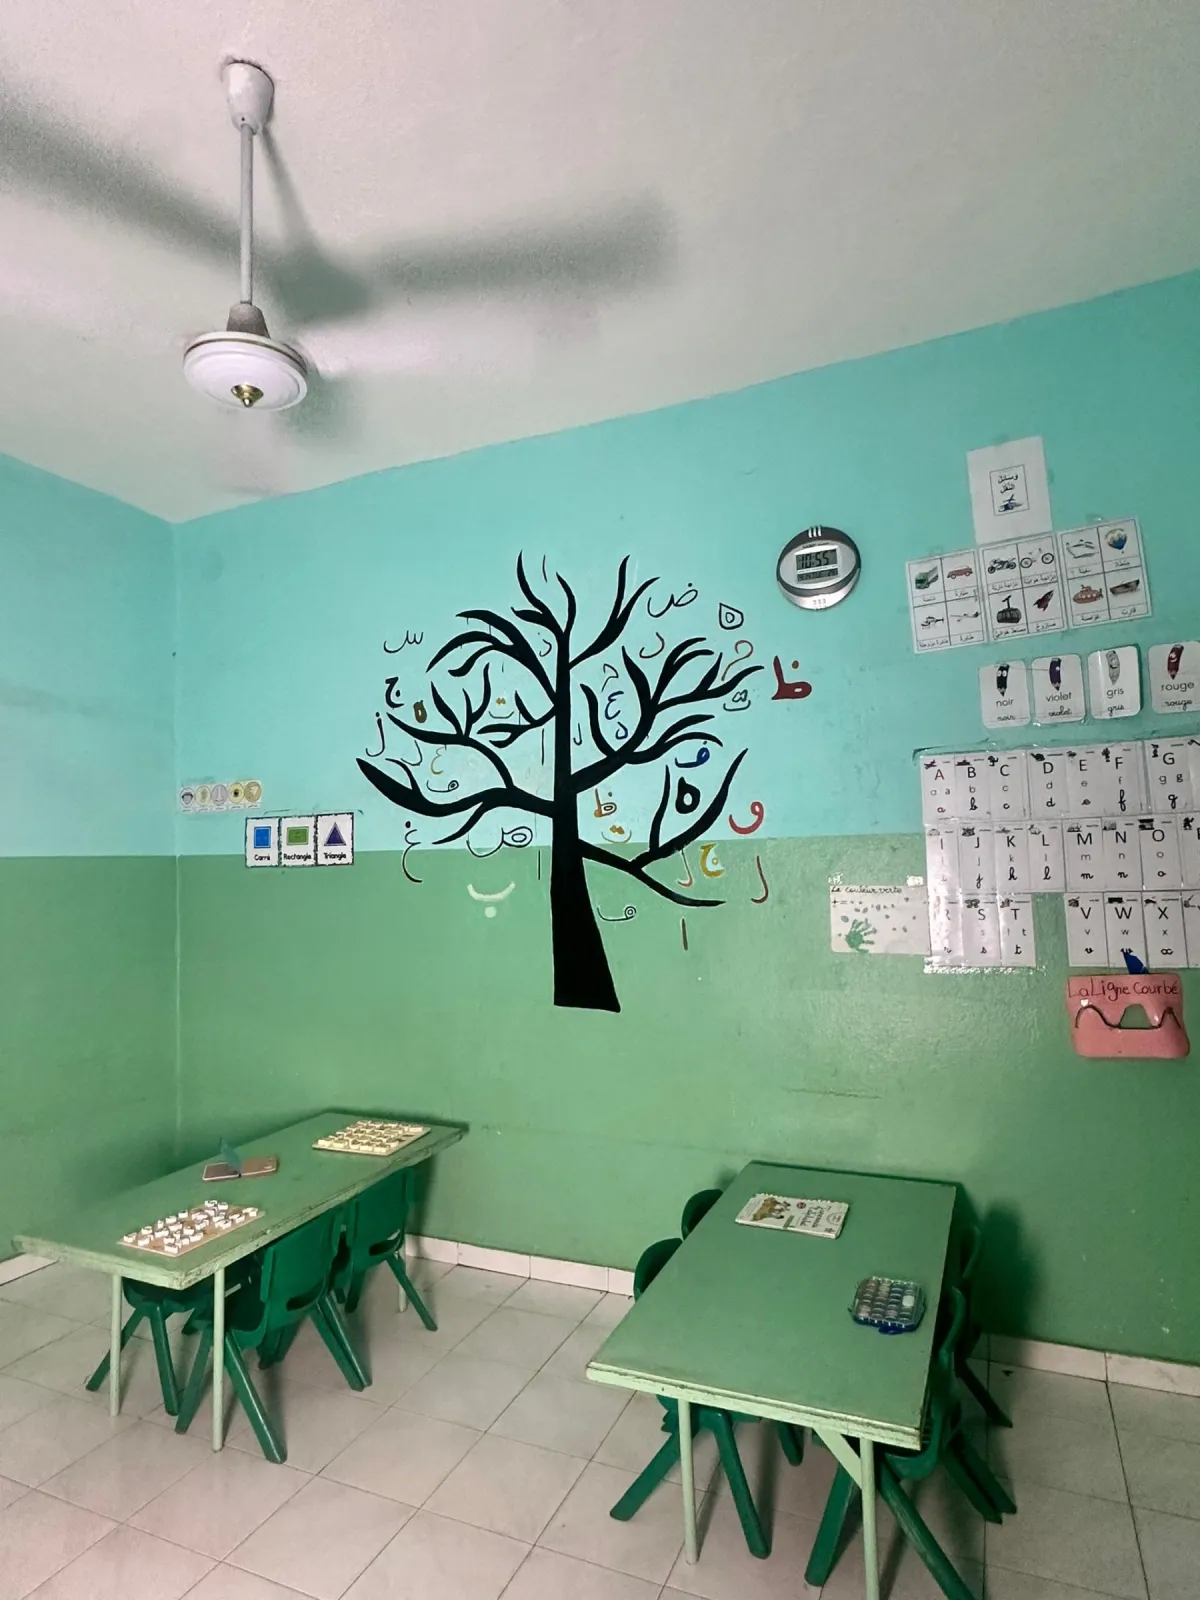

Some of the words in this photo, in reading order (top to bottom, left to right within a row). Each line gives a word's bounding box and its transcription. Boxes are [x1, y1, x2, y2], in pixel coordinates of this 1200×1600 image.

[801, 549, 829, 569] 10:55
[646, 582, 698, 618] ض
[383, 629, 424, 653] س
[771, 655, 812, 700] ظ
[1161, 682, 1195, 692] rouge
[385, 676, 405, 709] ج
[1046, 692, 1072, 702] violet
[1106, 687, 1125, 699] gris
[604, 690, 624, 720] ع
[996, 699, 1014, 707] noir
[1049, 705, 1072, 716] violet
[1108, 705, 1124, 717] gris
[1165, 699, 1193, 711] rouge
[675, 740, 711, 768] ف
[934, 769, 945, 780] A
[967, 766, 977, 778] B
[1000, 764, 1010, 776] C
[1043, 762, 1054, 774] D
[1079, 759, 1088, 771] E
[1115, 757, 1123, 769] F
[1162, 752, 1175, 765] G
[969, 785, 976, 793] b
[1046, 781, 1053, 789] d
[1159, 775, 1167, 785] g
[593, 788, 618, 818] ظ
[969, 797, 978, 811] b
[1046, 797, 1056, 807] d
[1118, 789, 1126, 811] f
[729, 801, 765, 834] و
[974, 837, 980, 848] J
[1006, 835, 1016, 847] K
[1041, 834, 1050, 846] L
[1077, 833, 1093, 845] M
[1115, 831, 1127, 843] N
[1152, 829, 1165, 842] O
[283, 852, 312, 861] Rectangle
[323, 852, 347, 861] Triangle
[402, 821, 422, 884] غ
[700, 843, 726, 878] ج
[1043, 866, 1051, 880] l
[1118, 871, 1128, 879] n
[467, 881, 516, 919] ب
[978, 909, 985, 921] S
[1011, 908, 1020, 920] T
[1080, 907, 1091, 919] V
[1115, 906, 1132, 919] W
[1157, 906, 1169, 919] X
[1022, 928, 1027, 936] t
[1014, 944, 1022, 954] t
[1068, 978, 1089, 998] La
[1091, 977, 1130, 1002] Ligne
